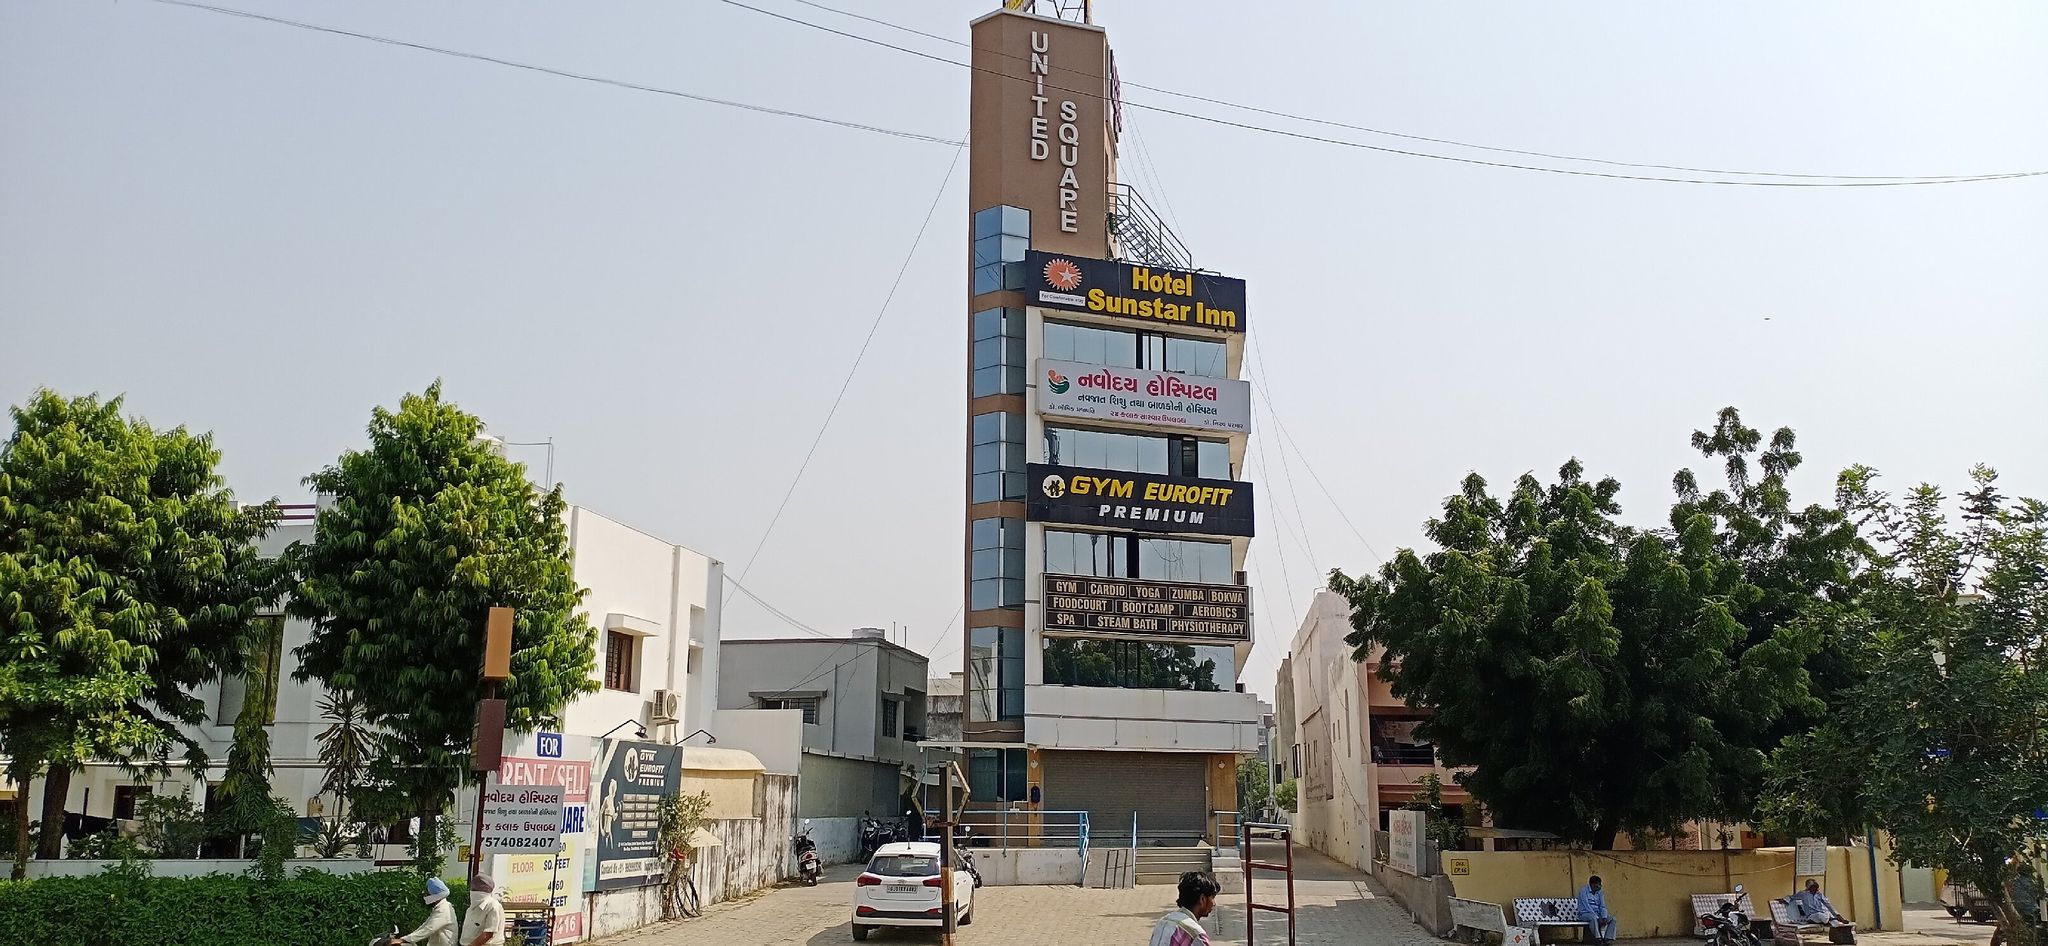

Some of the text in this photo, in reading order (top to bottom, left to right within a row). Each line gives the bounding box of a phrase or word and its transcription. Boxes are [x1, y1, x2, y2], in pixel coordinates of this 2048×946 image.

[1031, 30, 1049, 161] UNITED
[1058, 100, 1079, 233] SQUARE
[1132, 266, 1192, 297] Hotel
[1087, 288, 1236, 328] Sunstar Inn
[1077, 369, 1217, 401] નવોદય હોસ્પિટલ
[1077, 393, 1106, 404] નવજાત
[1109, 394, 1127, 409] શિશુ
[1129, 399, 1145, 408] તથા
[1186, 402, 1218, 415] હોસ્પિટલ
[1070, 475, 1234, 506] GYM EUROFIT
[1098, 504, 1205, 525] PREMIUM
[1056, 581, 1244, 604] GYM CARDIO YOGA ZUMBA BOKWA
[1053, 597, 1238, 618] FOODCOURT BOOTCAMP AEROBICS
[1057, 613, 1245, 635] SPA STEAM BATH PHYSIOTHERAPY
[540, 736, 559, 756] FOR
[640, 752, 655, 762] GYM
[640, 763, 666, 774] EUROFIT
[518, 790, 559, 804] હોસ્પિટલ
[495, 823, 520, 832] કલાક
[512, 861, 534, 874] FLOOR
[553, 896, 568, 907] FEET
